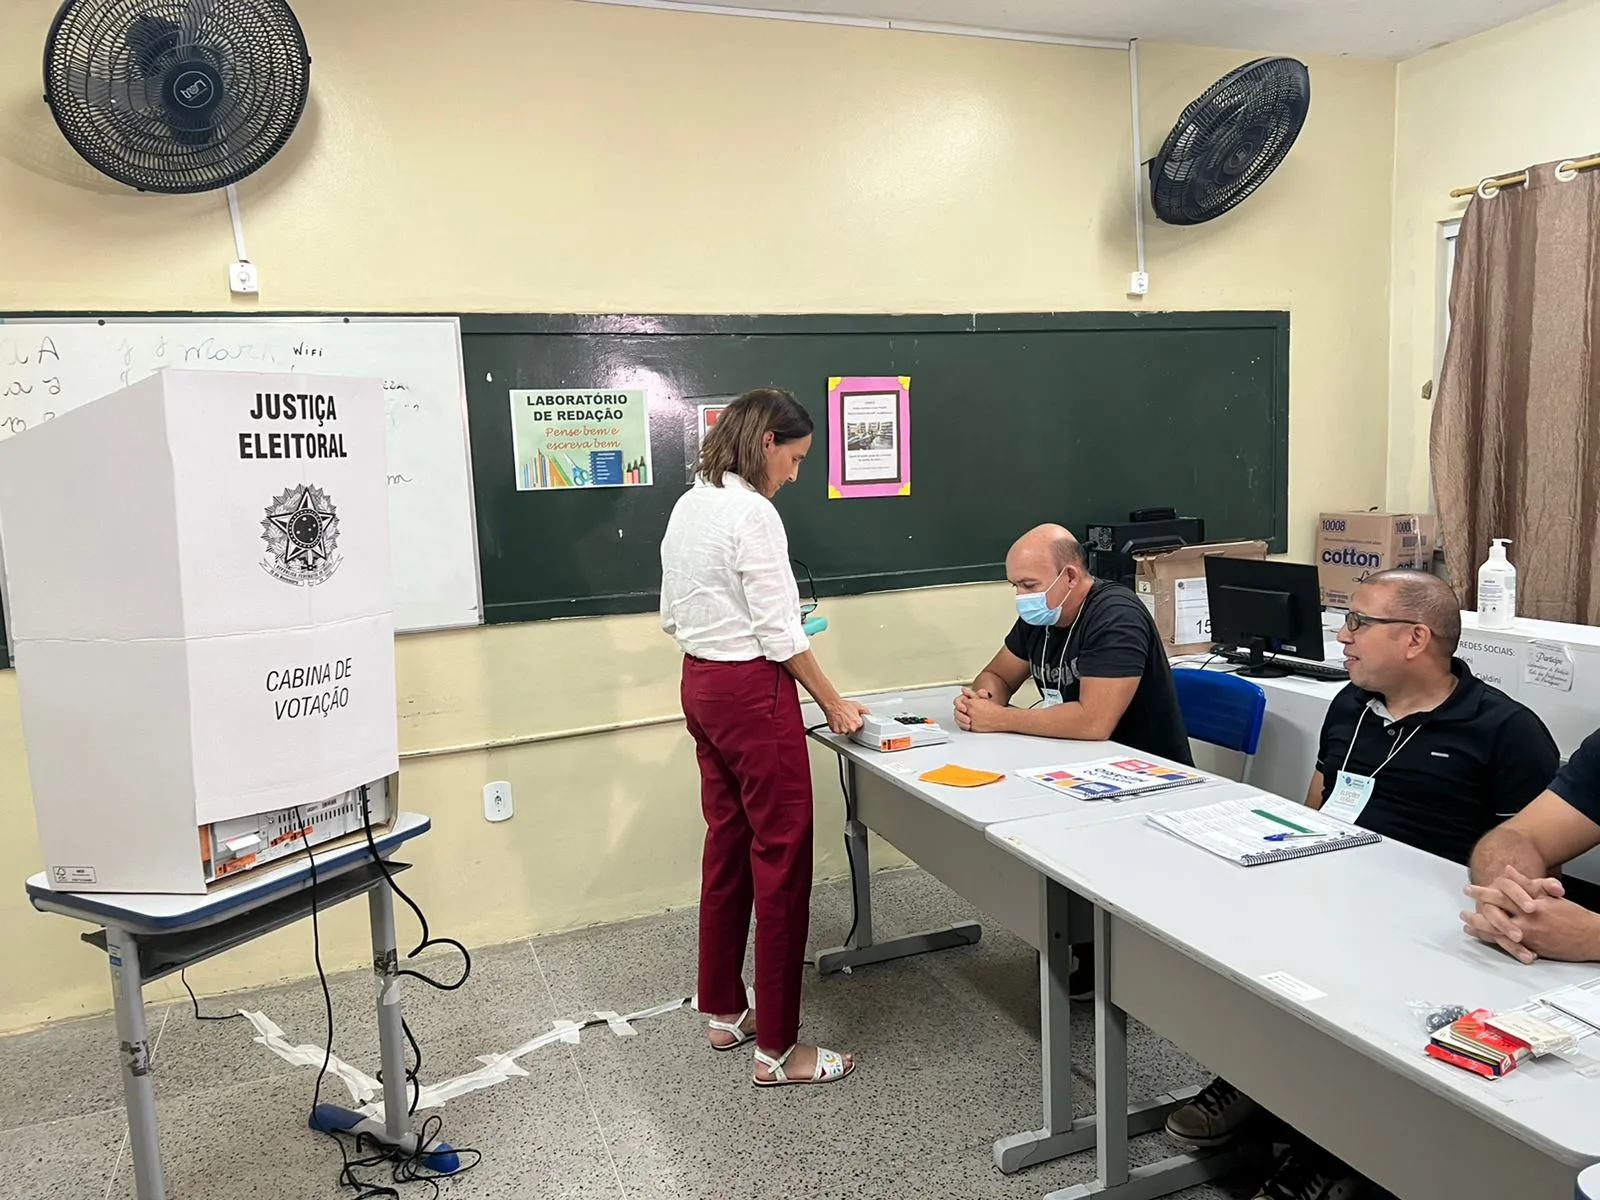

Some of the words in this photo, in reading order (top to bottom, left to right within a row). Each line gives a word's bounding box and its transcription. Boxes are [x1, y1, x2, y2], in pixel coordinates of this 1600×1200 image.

[526, 392, 628, 406] LABORATÓRIO
[250, 393, 337, 427] JUSTIÇA
[533, 411, 552, 421] DE
[557, 408, 624, 422] REDAÇÃO
[545, 427, 582, 437] Pense
[583, 425, 609, 436] bem
[611, 427, 620, 435] e
[238, 432, 347, 459] ELEITORAL
[546, 441, 592, 450] escreva
[594, 439, 621, 449] bem
[1322, 519, 1346, 532] 10008
[1321, 547, 1380, 568] cotton
[1460, 640, 1482, 651] REDES
[266, 663, 331, 692] CABINA
[335, 657, 352, 680] DE
[275, 686, 349, 720] VOTAÇÃO
